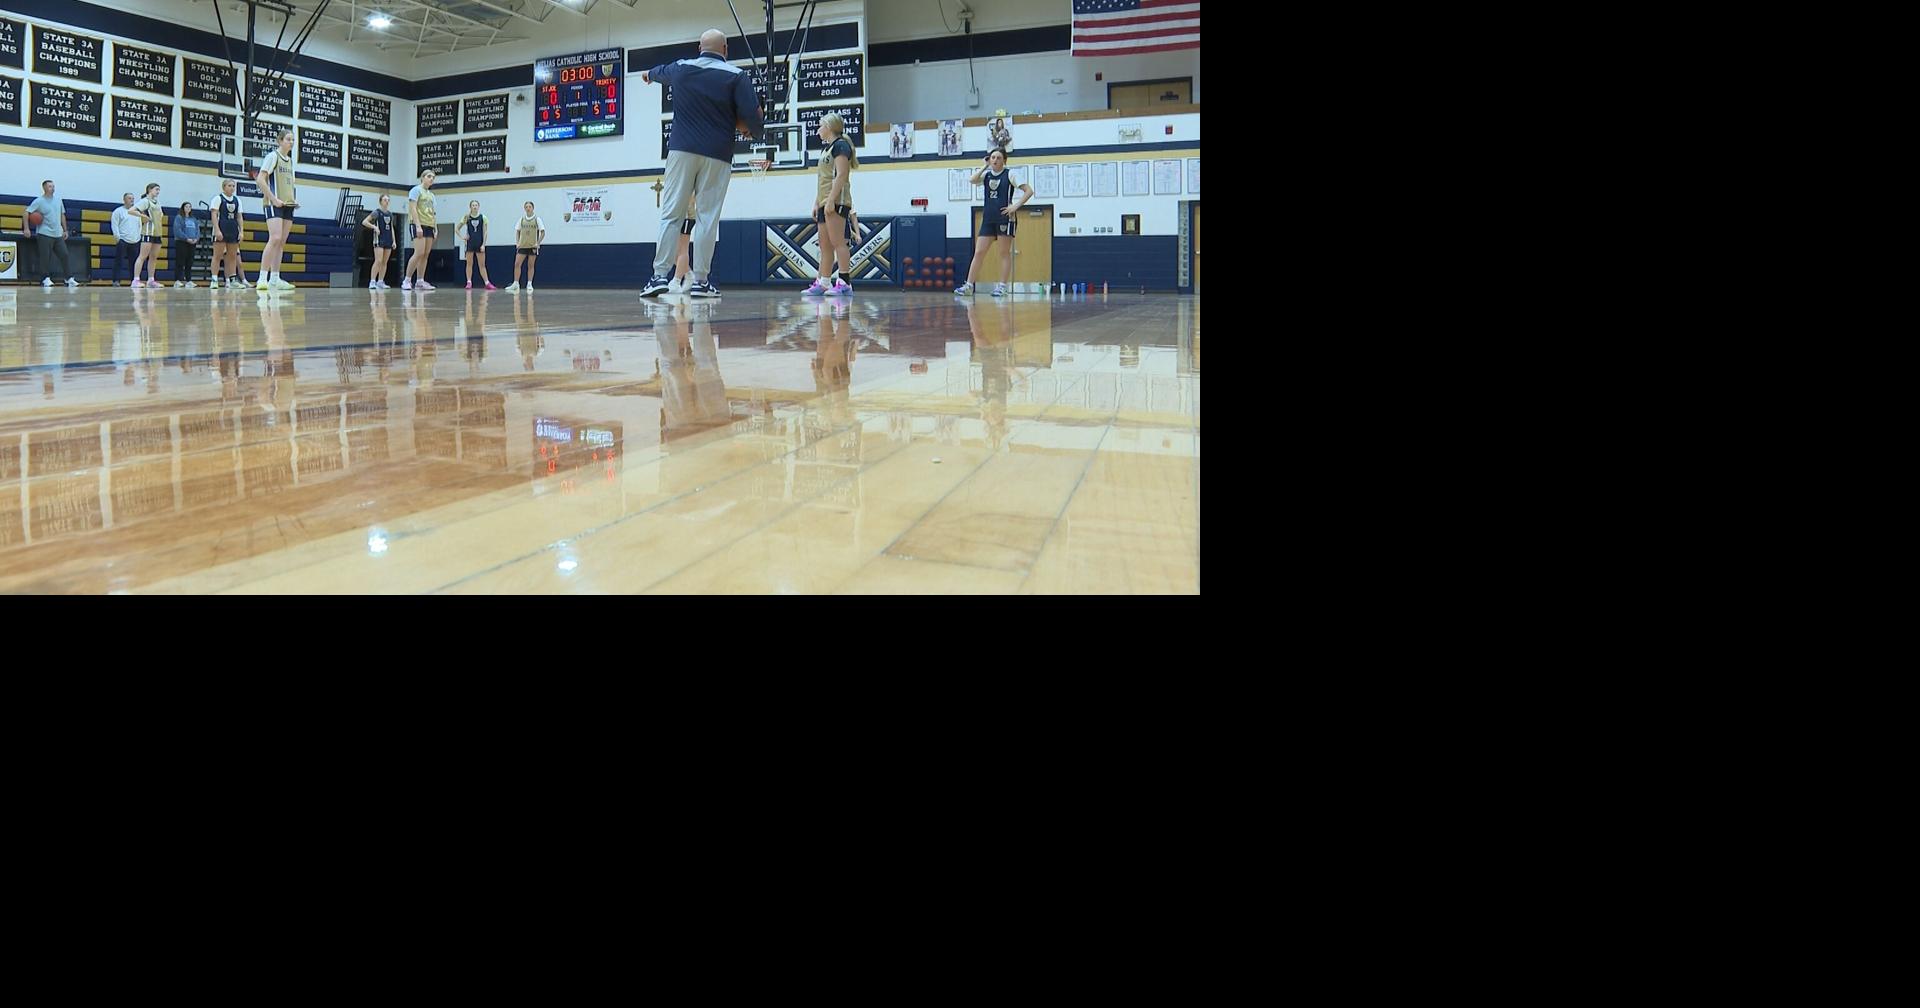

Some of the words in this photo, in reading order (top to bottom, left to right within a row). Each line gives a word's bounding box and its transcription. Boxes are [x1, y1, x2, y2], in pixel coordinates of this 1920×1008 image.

[43, 32, 75, 45] STATE
[81, 40, 94, 49] 3A
[41, 42, 94, 59] BASEBALL
[40, 52, 96, 70] CHAMPIONS
[122, 49, 150, 60] STATE
[157, 56, 166, 64] 3A
[557, 56, 582, 66] CATHOLIC
[584, 54, 596, 62] HIGH
[599, 50, 619, 60] SCHOOL
[119, 58, 170, 74] WRESTLING
[191, 64, 216, 74] STATE
[801, 62, 822, 70] STATE
[827, 60, 850, 68] CLASS
[59, 66, 78, 76] 1989
[118, 68, 168, 83] CHAMPIONS
[806, 69, 844, 78] FOOTBALL
[200, 74, 220, 82] GOLF
[596, 78, 616, 86] TRINITY
[804, 78, 858, 88] CHAMPIONS
[134, 80, 154, 89] 90-91
[188, 80, 232, 94] CHAMPIONS
[41, 87, 74, 99] STATE
[82, 94, 94, 102] 3A
[306, 86, 326, 95] STATE
[608, 85, 615, 98] 0
[821, 88, 840, 96] 2020
[202, 92, 218, 100] 1993
[300, 92, 320, 100] GIRLS
[322, 96, 343, 104] TRACK
[550, 92, 557, 104] 0
[44, 98, 71, 108] BOYS
[120, 100, 148, 111] STATE
[154, 106, 164, 114] 3A
[316, 102, 335, 110] FIELD
[352, 102, 368, 110] GIRLS
[371, 105, 389, 114] TRACK
[466, 100, 480, 108] STATE
[303, 106, 340, 117] CHAMPIONS
[468, 106, 504, 114] WRESTLING
[609, 104, 614, 113] 0
[36, 107, 96, 122] CHAMPIONS
[117, 110, 167, 124] WRESTLING
[190, 112, 214, 122] STATE
[220, 116, 228, 124] 3A
[422, 112, 453, 120] BASEBALL
[468, 114, 504, 122] CHAMPIONS
[543, 110, 548, 120] 0
[801, 110, 824, 118] STATE
[56, 120, 76, 129] 1990
[186, 120, 231, 132] WRESTLING
[354, 116, 386, 126] CHAMPIONS
[421, 119, 454, 128] CHAMPIONS
[117, 120, 166, 134] CHAMPIONS
[132, 131, 152, 140] 92-93
[186, 130, 220, 140] CHAMPIO
[304, 131, 324, 139] STATE
[200, 140, 218, 149] 93-94
[302, 139, 338, 150] WRESTLING
[302, 147, 338, 158] CHAMPIONS
[354, 147, 383, 156] FOOTBALL
[422, 152, 453, 160] BASEBALL
[466, 148, 500, 156] SOFTBALL
[352, 154, 384, 164] CHAMPIONS
[422, 160, 454, 168] CHAMPIONS
[465, 155, 502, 163] CHAMPIONS
[778, 243, 804, 268] HELIAS
